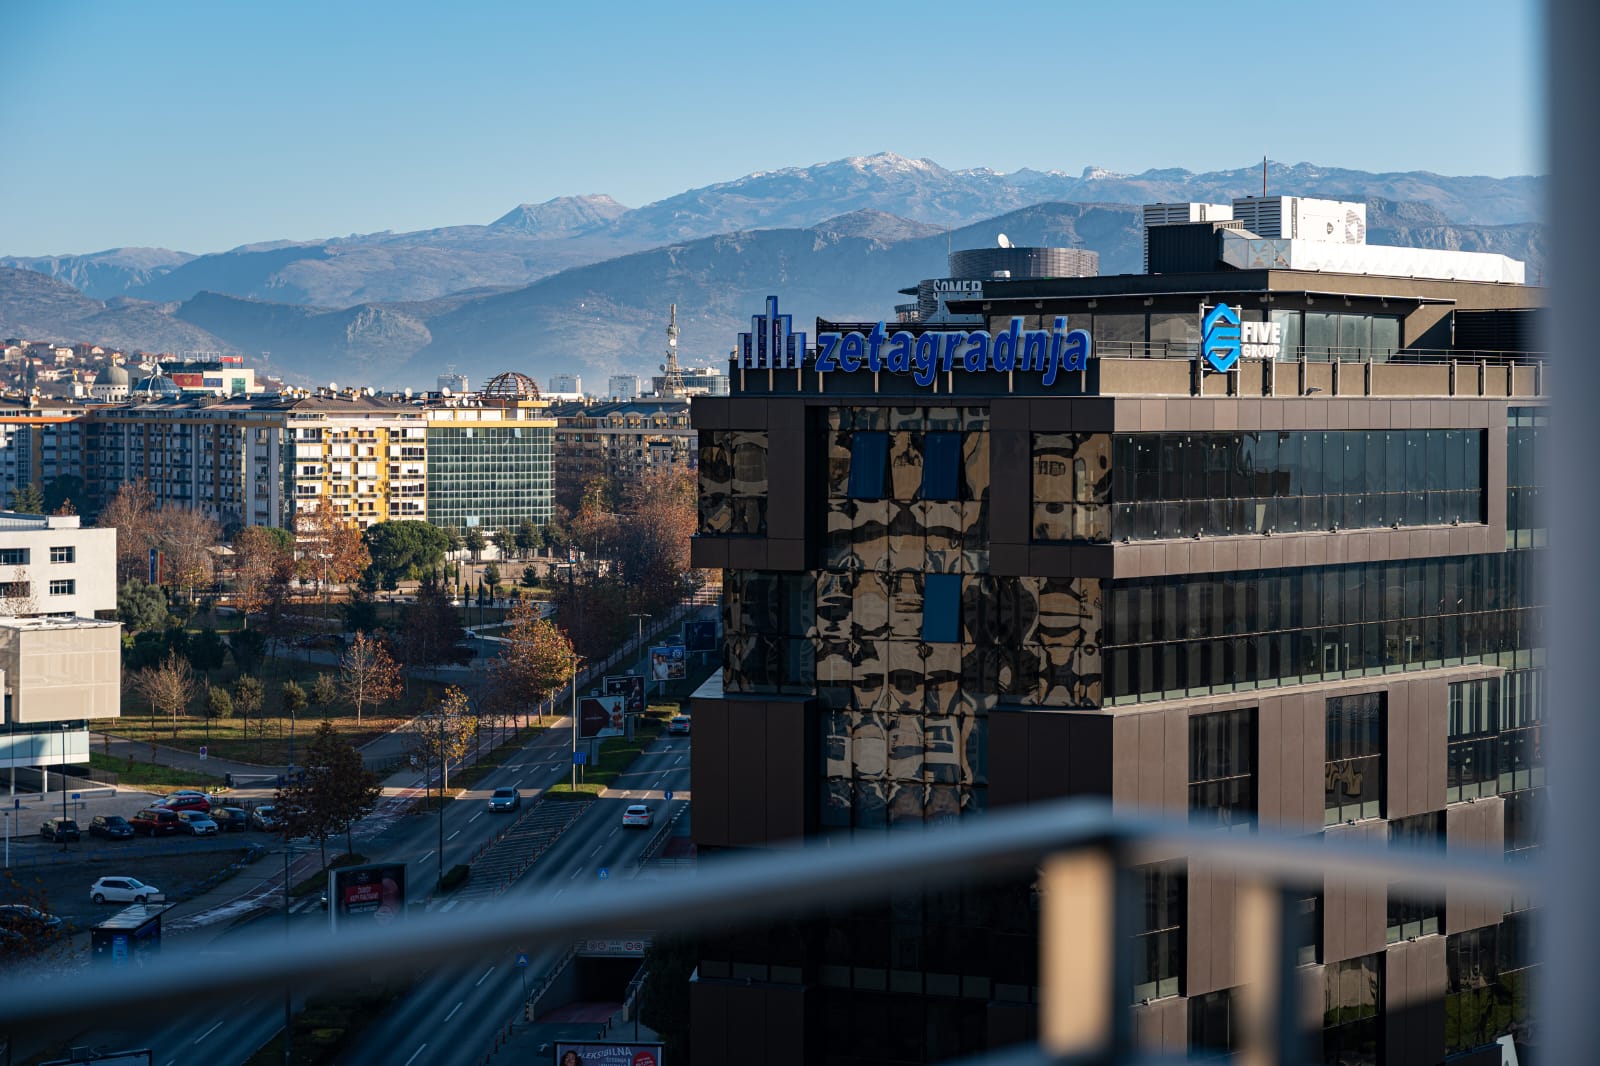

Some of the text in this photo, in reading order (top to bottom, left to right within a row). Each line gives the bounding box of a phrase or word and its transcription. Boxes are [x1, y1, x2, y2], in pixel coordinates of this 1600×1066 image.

[1241, 321, 1281, 343] FIVE
[815, 316, 1091, 387] zetagradnja
[1242, 344, 1280, 358] GROUP
